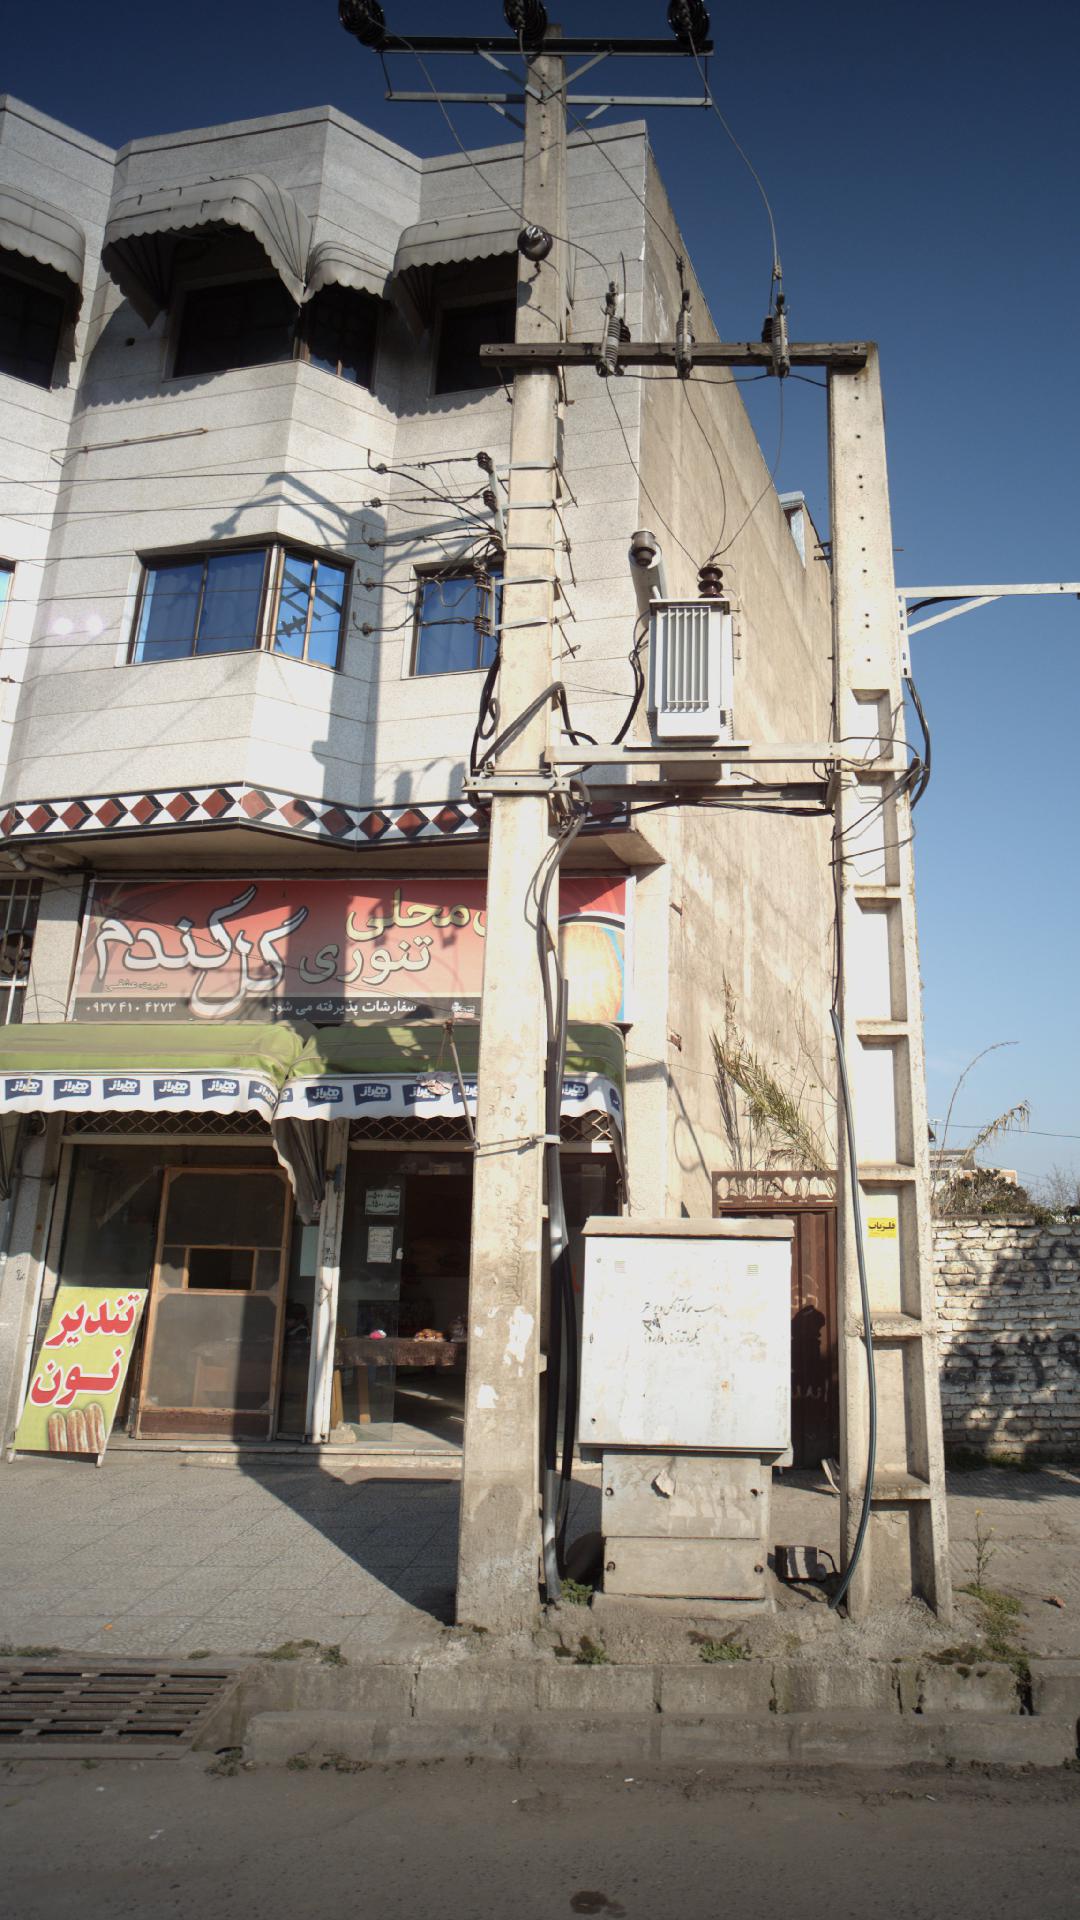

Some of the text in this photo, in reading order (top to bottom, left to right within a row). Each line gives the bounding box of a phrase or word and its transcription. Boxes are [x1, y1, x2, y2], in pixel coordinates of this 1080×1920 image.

[346, 888, 470, 942] محلی
[97, 884, 309, 1018] گل گندم
[300, 935, 434, 985] تنوری
[269, 1000, 417, 1016] سفارشات پذیرفته می شود
[45, 1293, 140, 1347] تندیر
[30, 1347, 123, 1406] نون
